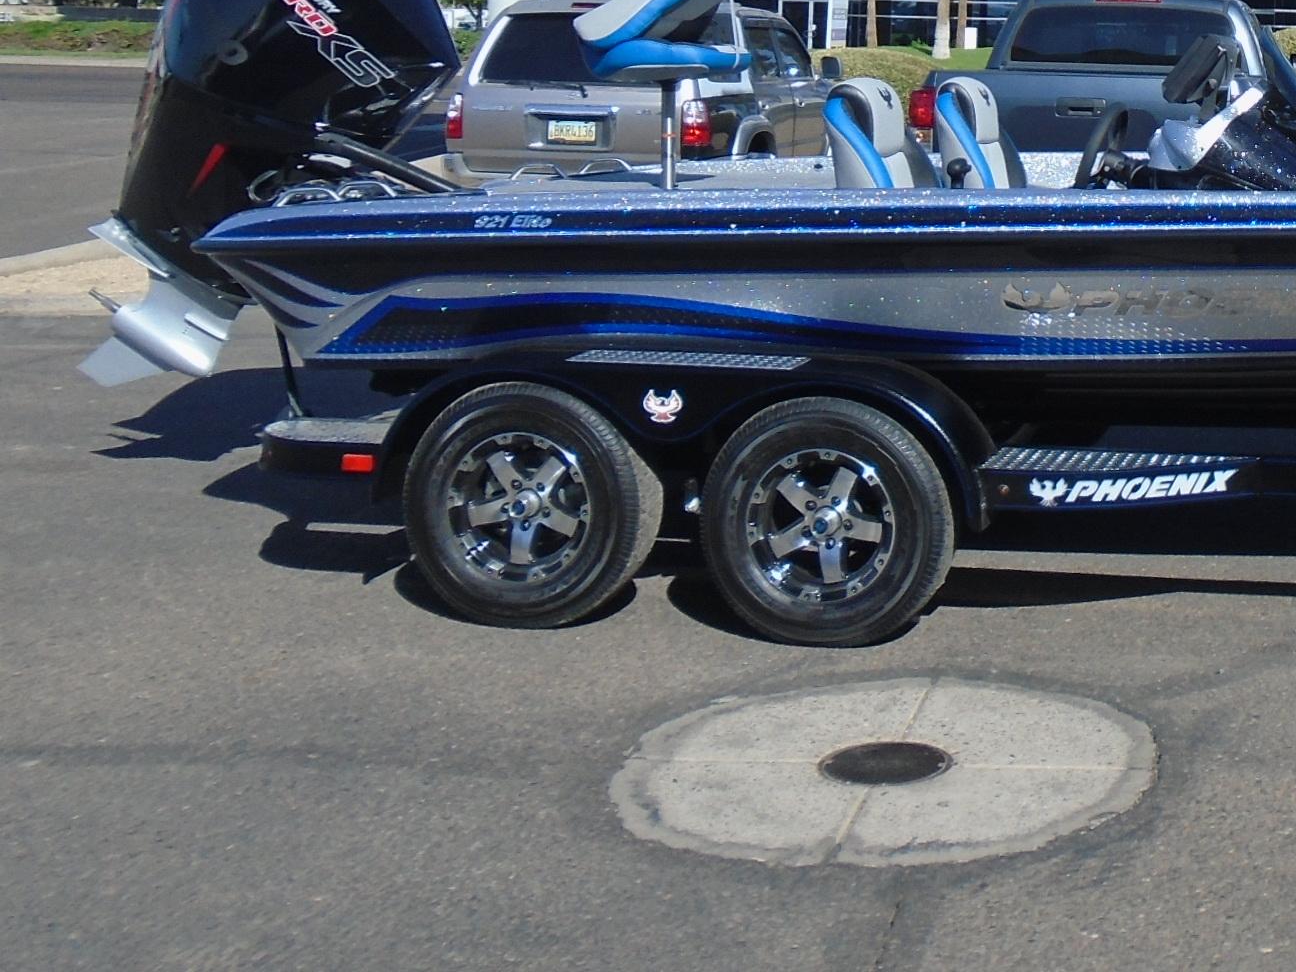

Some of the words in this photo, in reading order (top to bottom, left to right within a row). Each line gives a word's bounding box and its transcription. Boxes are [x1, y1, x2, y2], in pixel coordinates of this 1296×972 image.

[286, 19, 396, 87] XS
[474, 215, 507, 228] 921
[509, 214, 552, 228] Elite
[1065, 468, 1239, 504] PHOENIX
